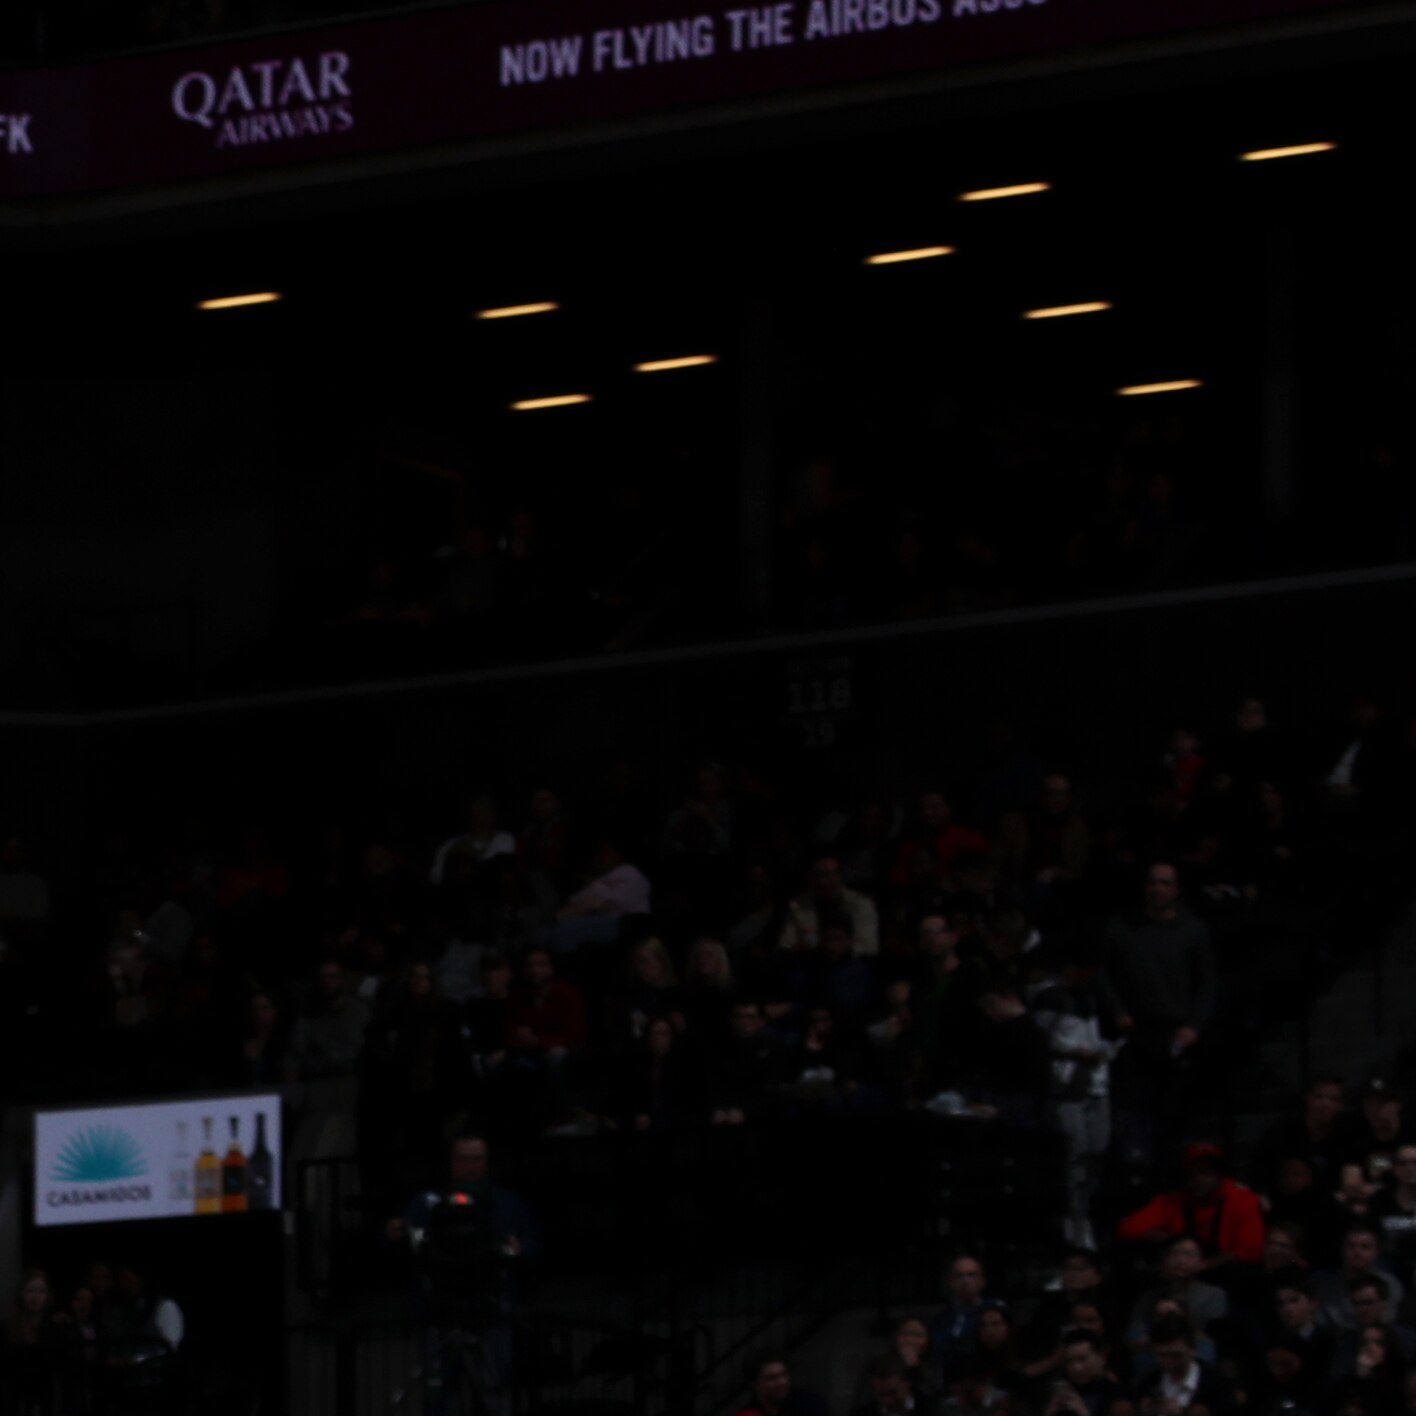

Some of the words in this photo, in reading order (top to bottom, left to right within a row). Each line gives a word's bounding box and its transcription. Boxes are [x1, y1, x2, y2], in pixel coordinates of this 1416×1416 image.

[500, 37, 583, 87] NOW
[592, 16, 716, 72] FLYING
[726, 5, 794, 51] THE
[172, 51, 353, 127] QATAR
[215, 102, 355, 149] AIRWAYS
